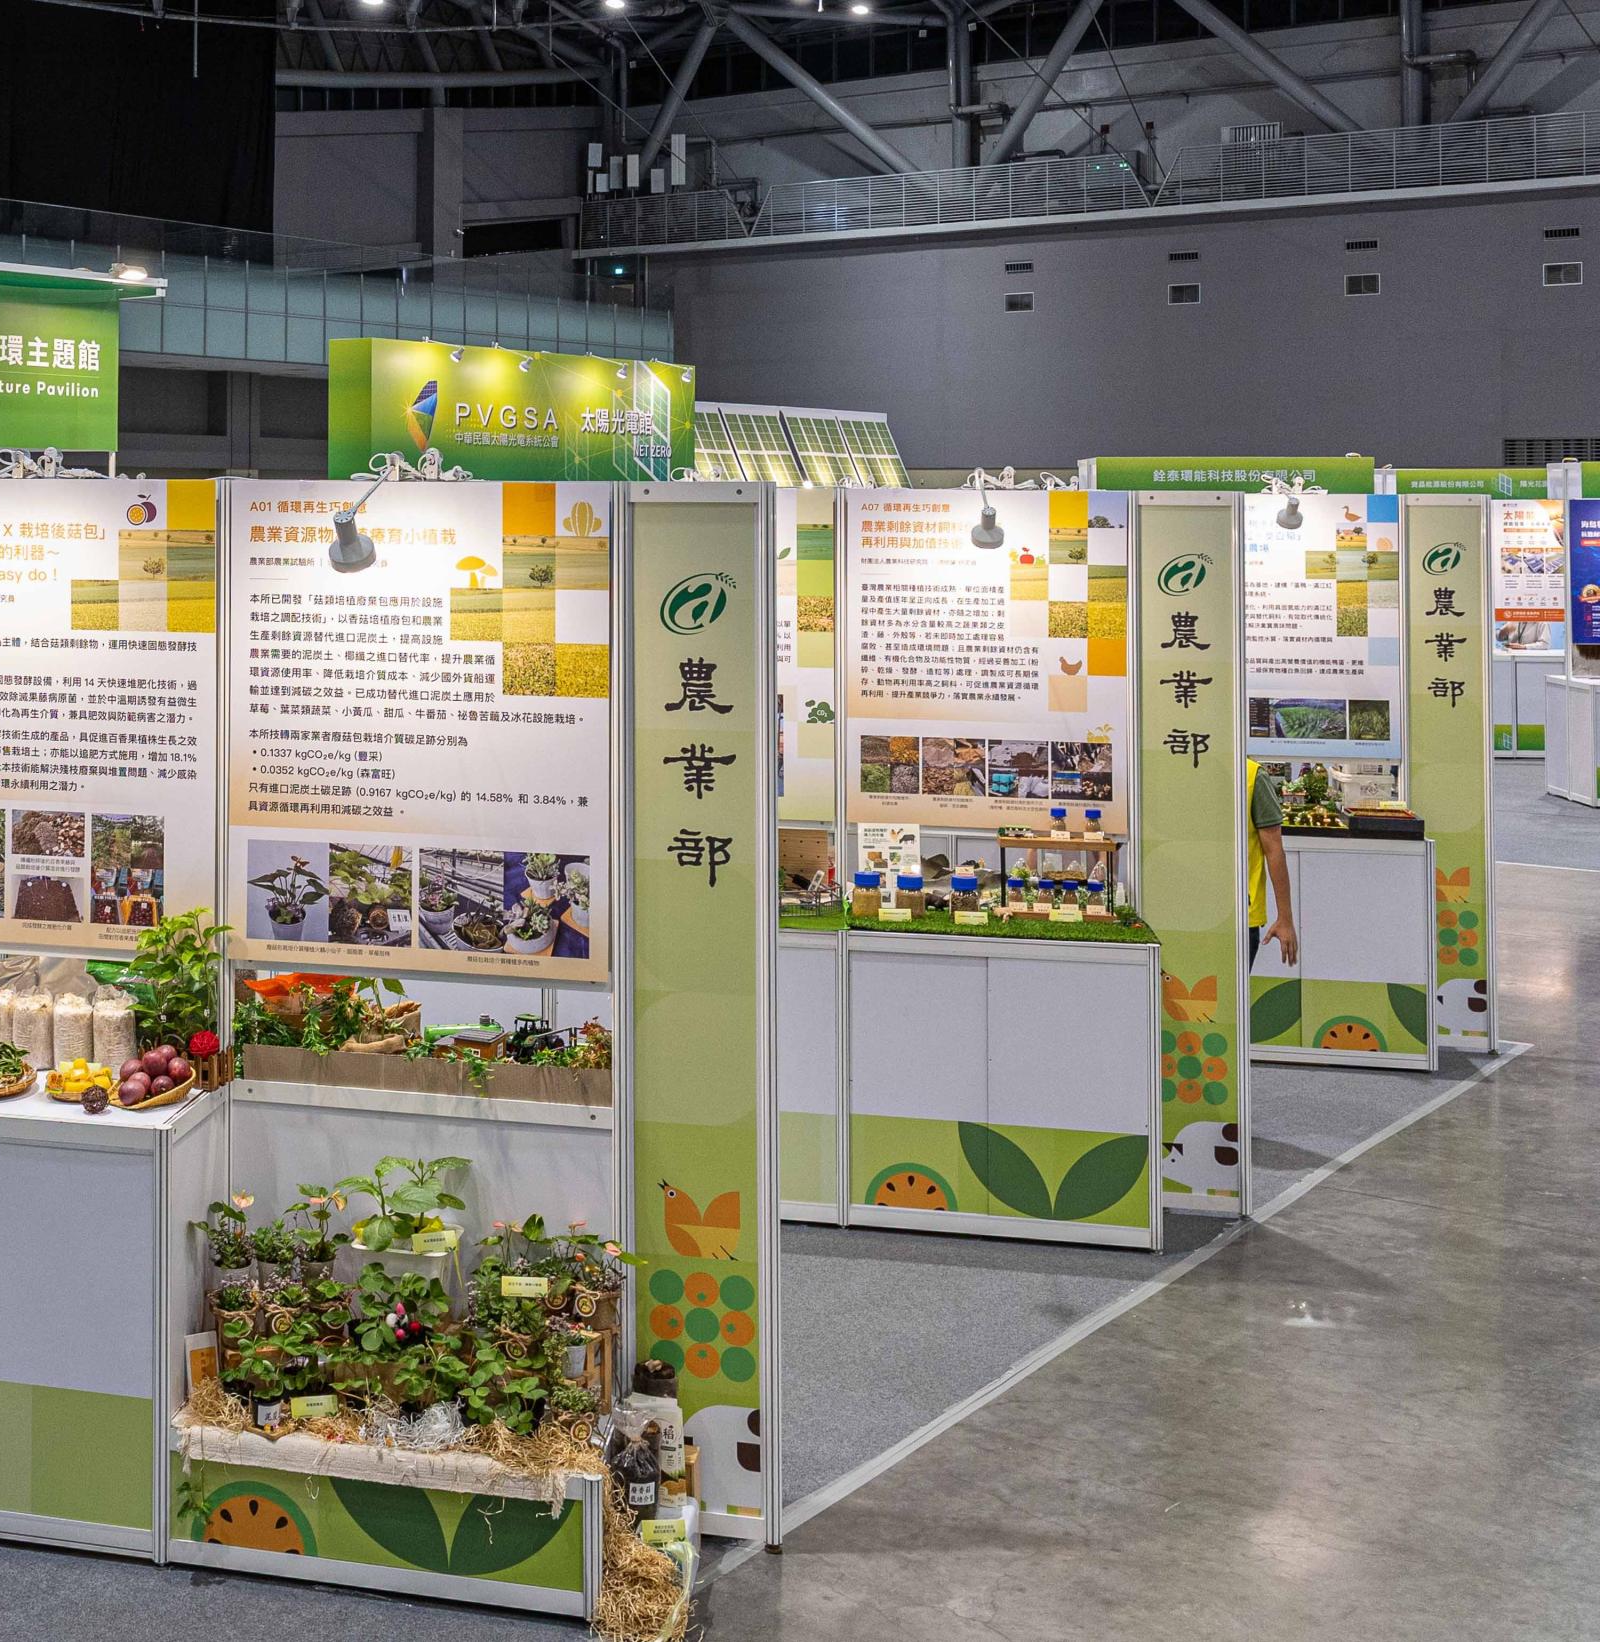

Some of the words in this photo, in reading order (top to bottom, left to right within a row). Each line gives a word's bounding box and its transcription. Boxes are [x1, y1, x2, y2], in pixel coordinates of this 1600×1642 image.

[37, 381, 99, 398] Pavilion
[455, 402, 559, 431] PVGSA
[581, 407, 653, 436] 太陽光電館
[455, 432, 559, 449] 中華民國太陽光電系統公會
[634, 444, 650, 458] NET
[650, 445, 672, 459] ZERO
[250, 502, 272, 513] A01
[861, 503, 879, 512] A07
[883, 503, 950, 513] 循環再生巧創意
[3, 524, 13, 537] X
[1425, 587, 1467, 708] 農業部
[85, 678, 95, 687] 14
[1160, 611, 1213, 769] 農業部
[170, 752, 197, 763] 18.1%
[260, 748, 292, 758] 0.1337
[260, 765, 294, 775] 0.0352
[663, 656, 736, 887] 農業部
[356, 787, 392, 798] (0.9167
[460, 791, 472, 802] 的
[476, 792, 513, 803] 14.58%
[518, 793, 529, 804] 和
